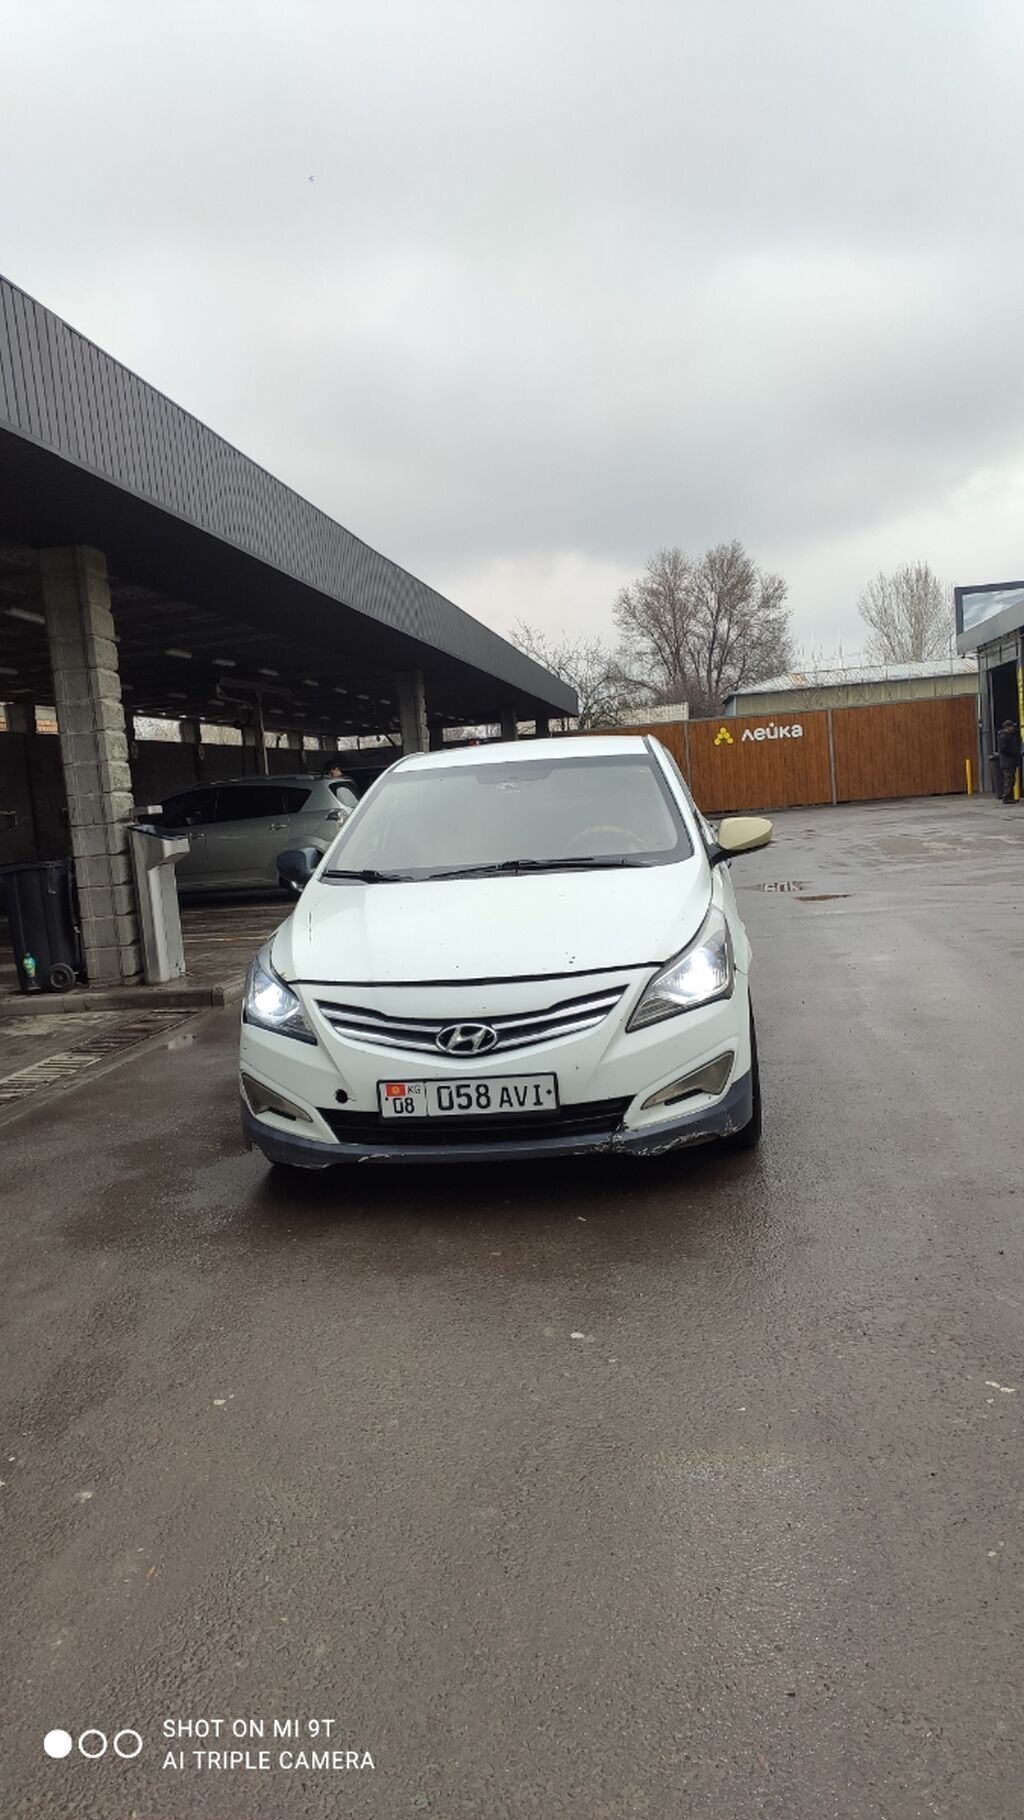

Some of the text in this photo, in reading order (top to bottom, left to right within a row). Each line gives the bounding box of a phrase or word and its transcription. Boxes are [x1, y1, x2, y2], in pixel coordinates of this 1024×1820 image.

[407, 1085, 421, 1094] KG
[436, 1084, 544, 1111] 058 AVI
[393, 1097, 415, 1114] 08
